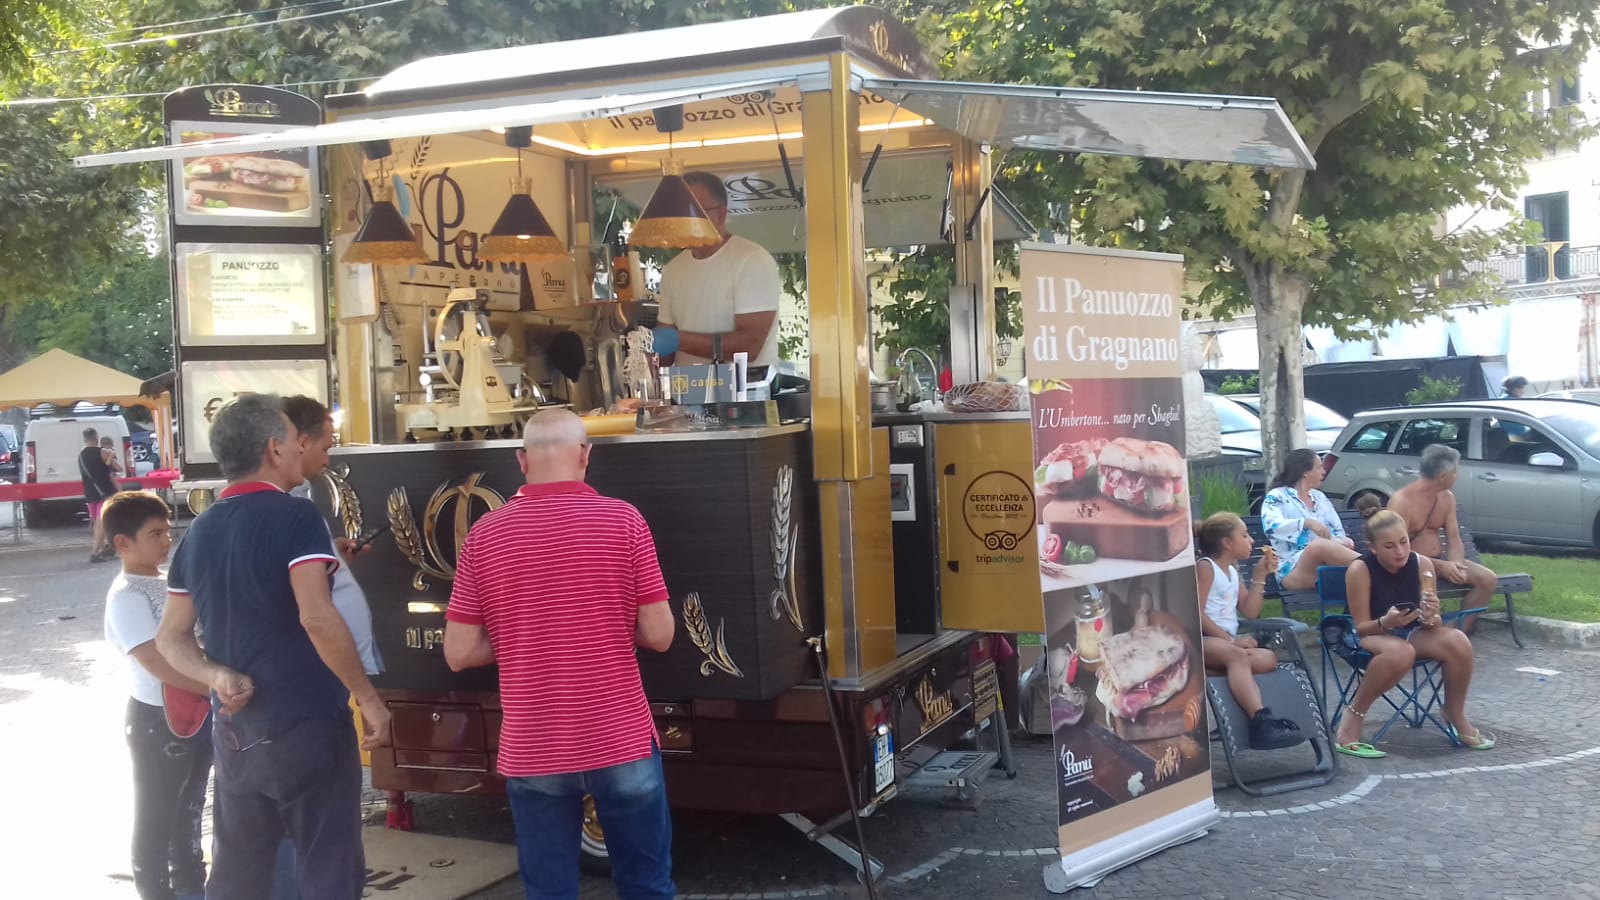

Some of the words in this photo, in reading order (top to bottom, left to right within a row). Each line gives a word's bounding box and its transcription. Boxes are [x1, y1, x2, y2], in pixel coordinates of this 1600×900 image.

[743, 103, 764, 117] di
[1036, 276, 1057, 313] Il
[1064, 277, 1172, 318] Panuozzo
[1032, 325, 1058, 361] di
[1066, 325, 1178, 371] Gragnano
[1132, 413, 1146, 429] per
[970, 494, 1019, 502] CERTIFICATO
[975, 504, 1024, 512] ECCELLENZA
[976, 554, 1025, 566] tripadvisor
